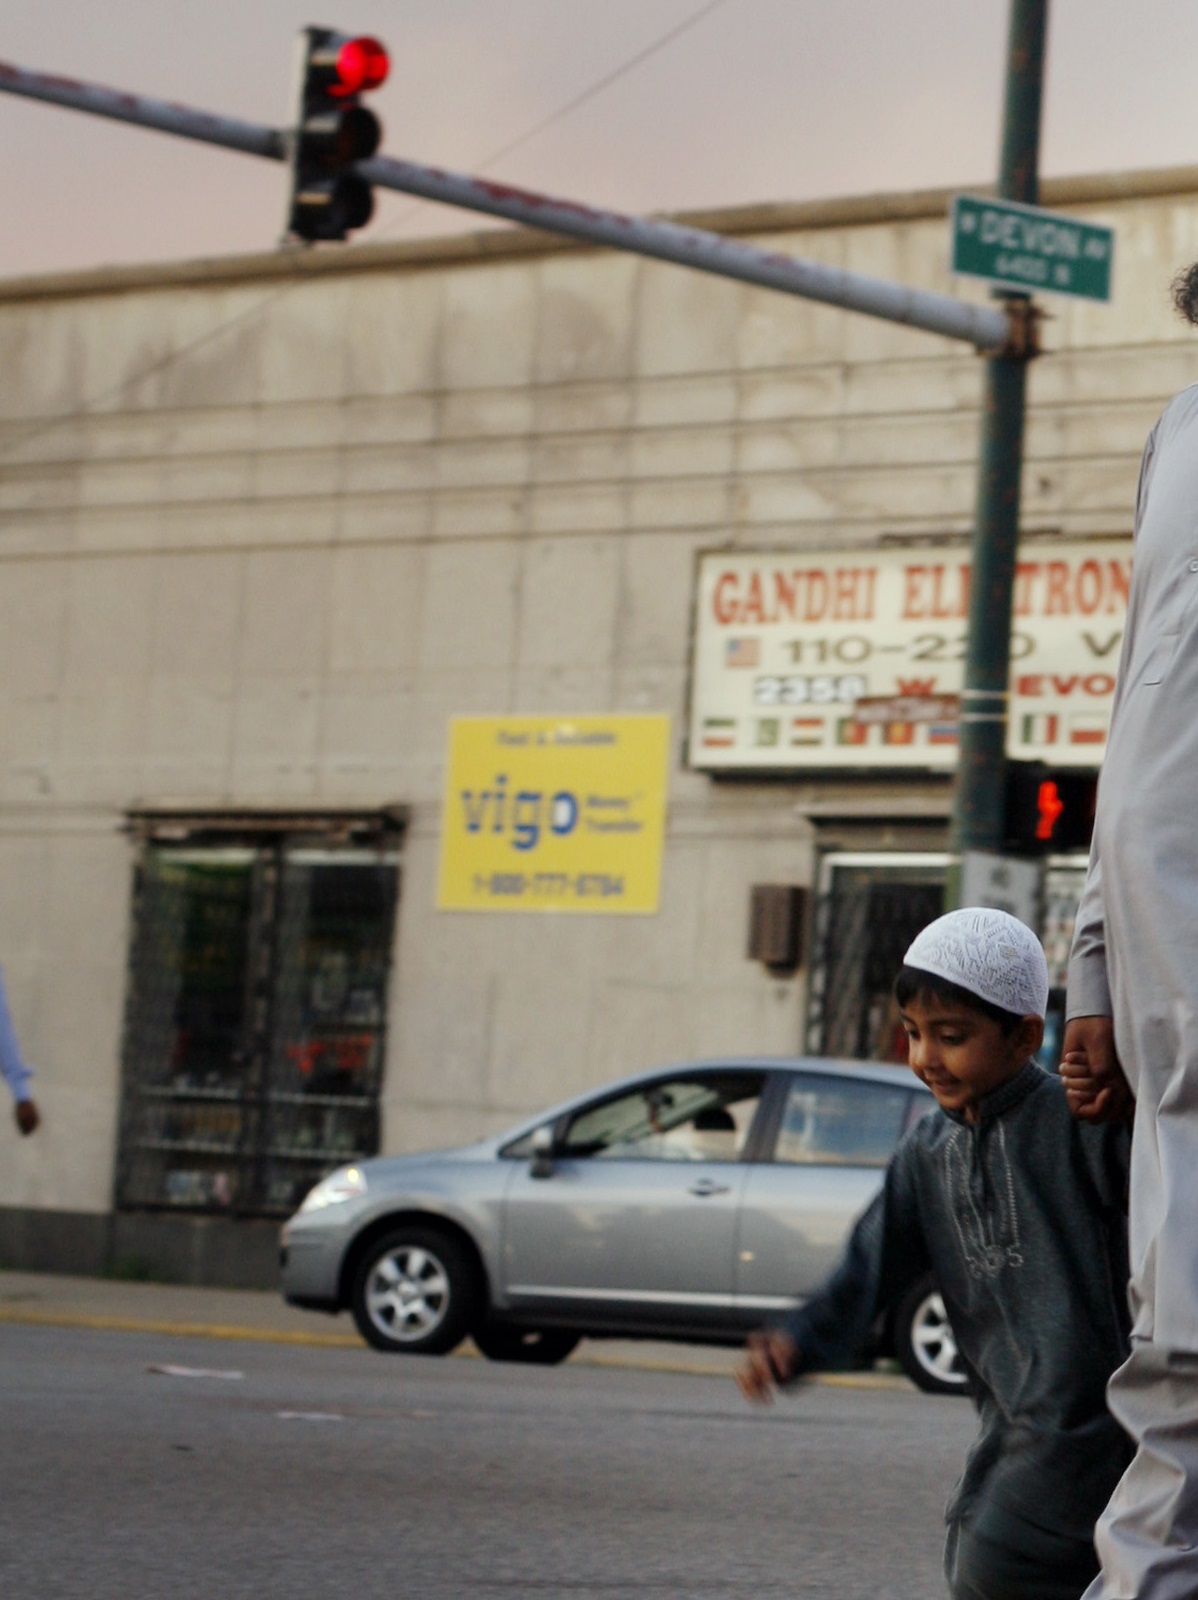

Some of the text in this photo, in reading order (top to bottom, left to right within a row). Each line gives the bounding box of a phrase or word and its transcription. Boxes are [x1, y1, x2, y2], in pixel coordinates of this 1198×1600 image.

[980, 210, 1081, 258] DEVON
[713, 559, 1133, 626] GANDHI ELTRON
[1016, 673, 1117, 698] EVO
[462, 773, 579, 851] vigo
